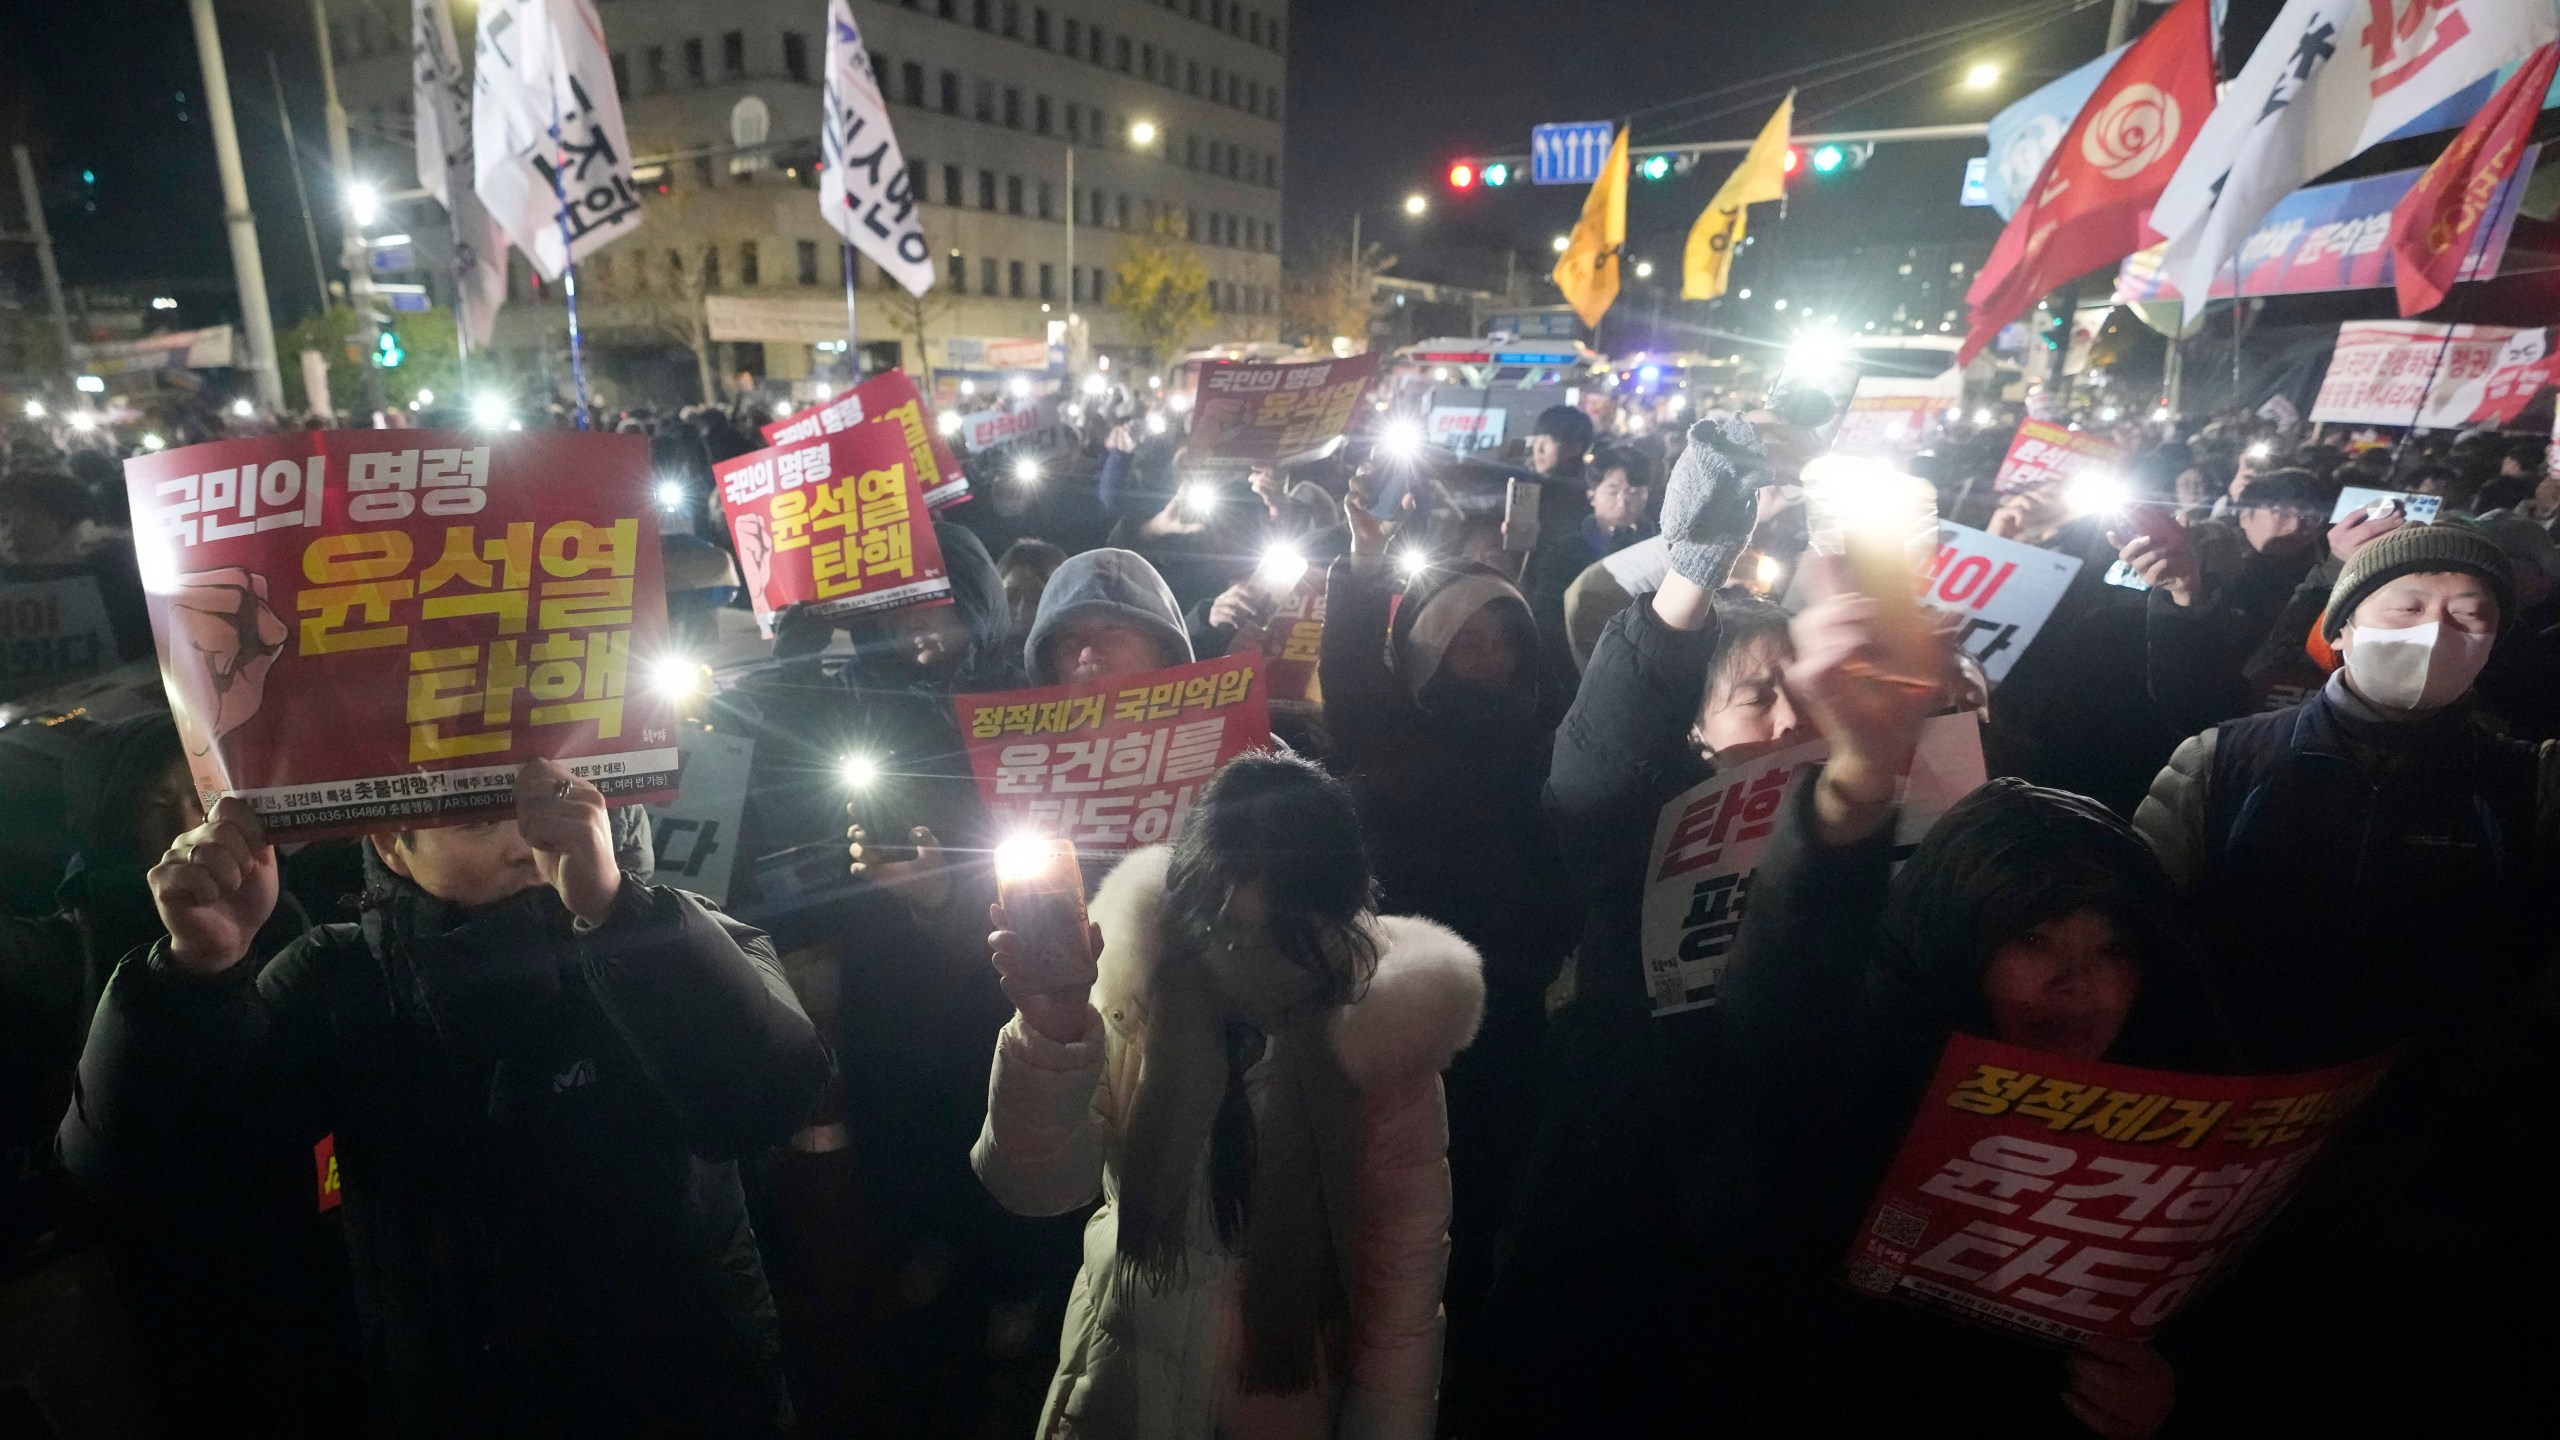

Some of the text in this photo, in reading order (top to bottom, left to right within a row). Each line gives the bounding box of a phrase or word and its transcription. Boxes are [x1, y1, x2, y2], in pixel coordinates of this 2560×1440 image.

[819, 394, 864, 434] 명령
[1208, 364, 1331, 391] 국민의 명령
[152, 446, 491, 547] 국민의 명령
[724, 443, 832, 505] 국민의 명령
[769, 463, 909, 554] 윤석열
[297, 518, 640, 657] 윤석열
[811, 521, 914, 600] 탄핵
[406, 630, 630, 763] 탄핵
[972, 666, 1254, 739] 정적제거 국민억압
[283, 789, 324, 808] 김건희
[326, 788, 352, 804] 특검
[354, 773, 447, 801] 촛불대행진
[483, 773, 516, 787] 토요일
[591, 763, 602, 777] 앞
[604, 761, 626, 775] 대로)
[995, 716, 1226, 794] 윤건희를
[293, 804, 387, 825] 100-036-164860
[444, 795, 469, 811] ARS
[615, 777, 634, 790] 여러
[635, 776, 645, 788] 번
[646, 773, 668, 787] 기능)
[1029, 785, 1194, 844] 타도하
[1946, 1063, 2234, 1151] 정적제거
[1916, 1134, 2315, 1244] 윤건희
